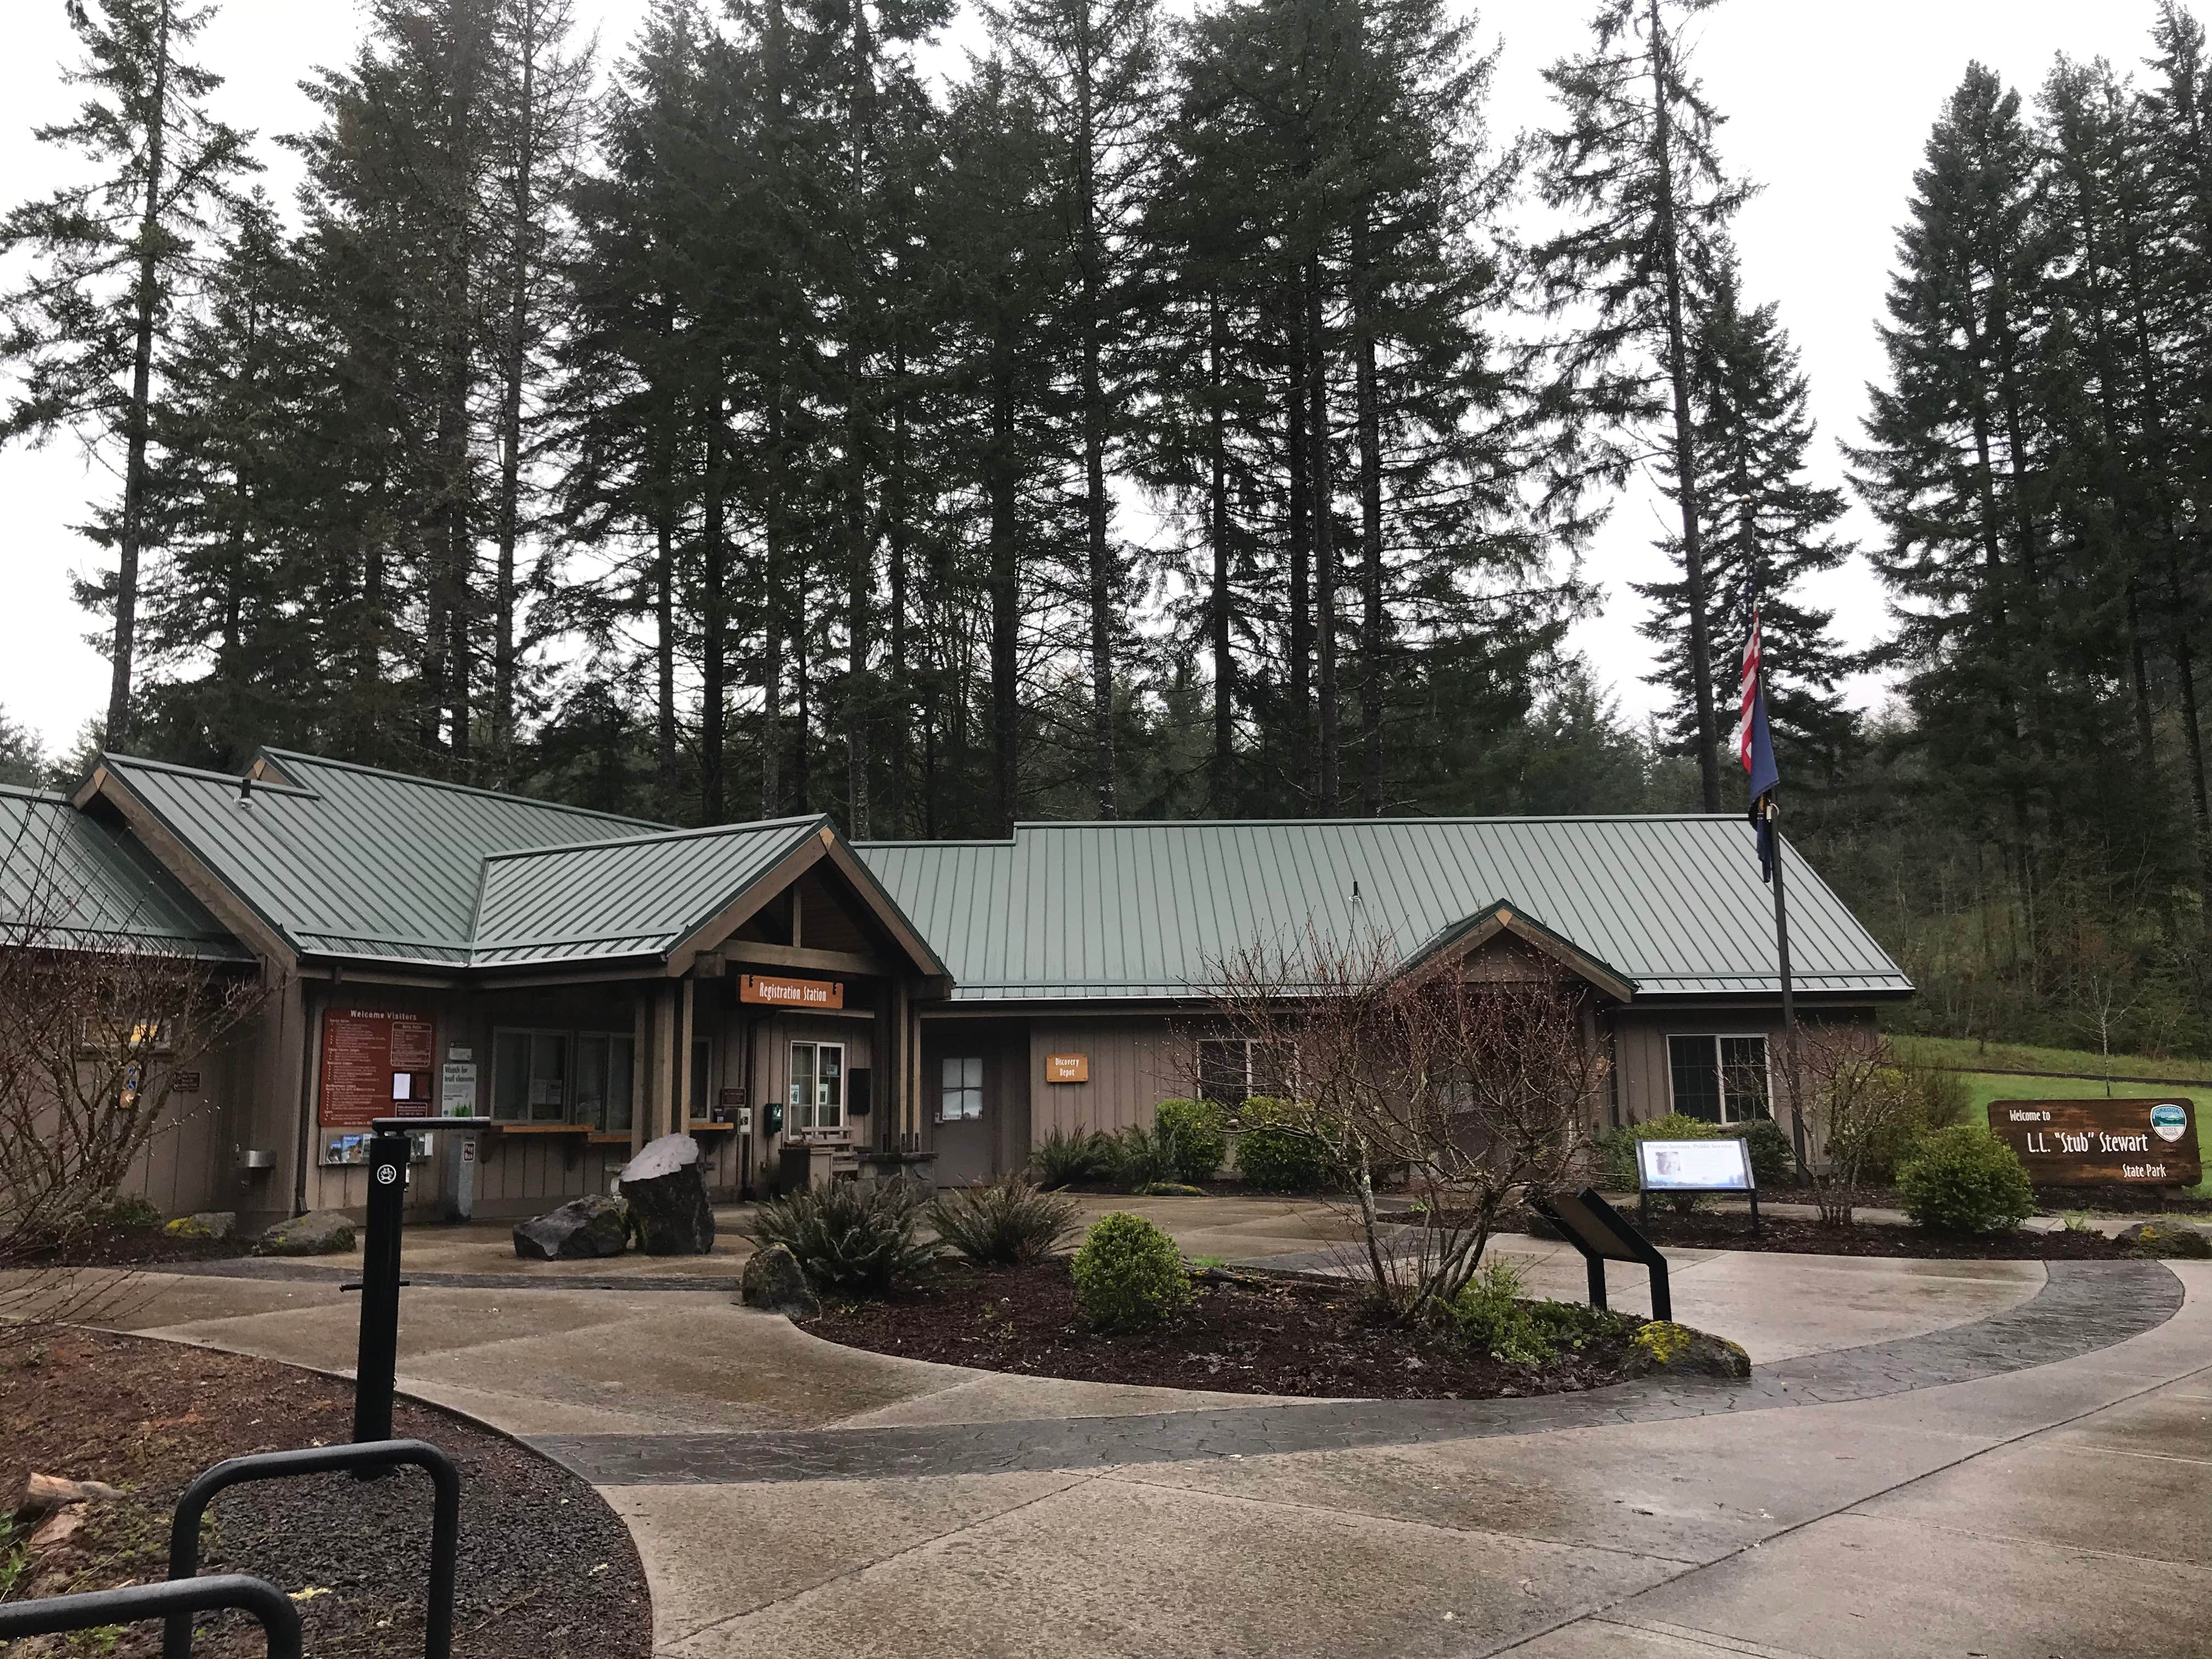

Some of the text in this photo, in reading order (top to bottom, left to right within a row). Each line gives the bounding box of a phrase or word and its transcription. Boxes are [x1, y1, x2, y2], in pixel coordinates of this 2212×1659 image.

[759, 982, 826, 1002] Registration Station
[351, 1010, 417, 1020] Welcome Visitors
[1055, 1057, 1079, 1067] Discovery
[1059, 1068, 1075, 1077] Depot
[2009, 1109, 2051, 1121] Welcome to
[2027, 1131, 2149, 1153] L.L. "Stub" Stewart
[2122, 1163, 2167, 1178] State Park
